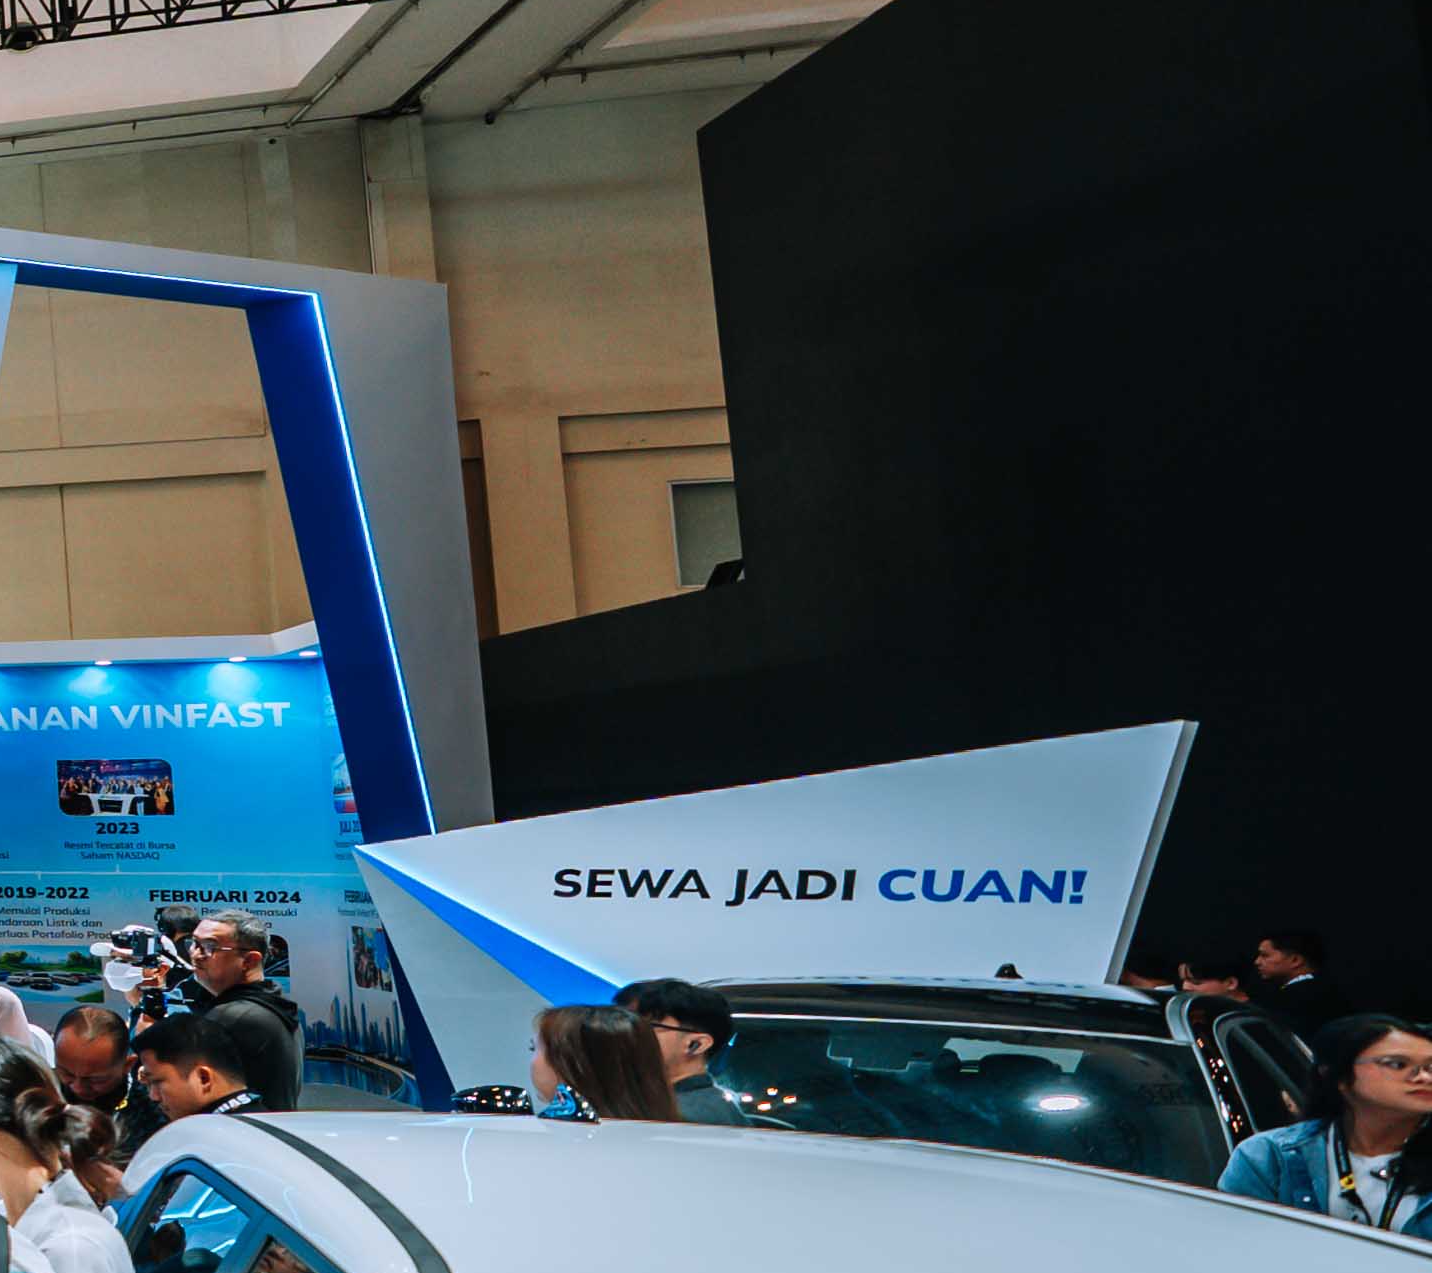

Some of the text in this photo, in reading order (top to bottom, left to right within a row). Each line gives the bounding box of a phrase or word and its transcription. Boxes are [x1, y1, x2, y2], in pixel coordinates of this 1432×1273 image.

[109, 702, 291, 728] VINFAST
[95, 822, 140, 835] 2023
[64, 840, 176, 849] Resmi Tercatat di Bursa
[81, 851, 161, 861] Saham NASDAQ
[553, 868, 1089, 907] SEWA JADI CUAN!
[149, 889, 302, 904] FEBRUARI 2024
[43, 906, 91, 916] Produksi
[46, 918, 79, 927] Listrik
[81, 918, 103, 928] dan
[32, 929, 84, 939] Portofolio
[87, 930, 113, 940] Prod
